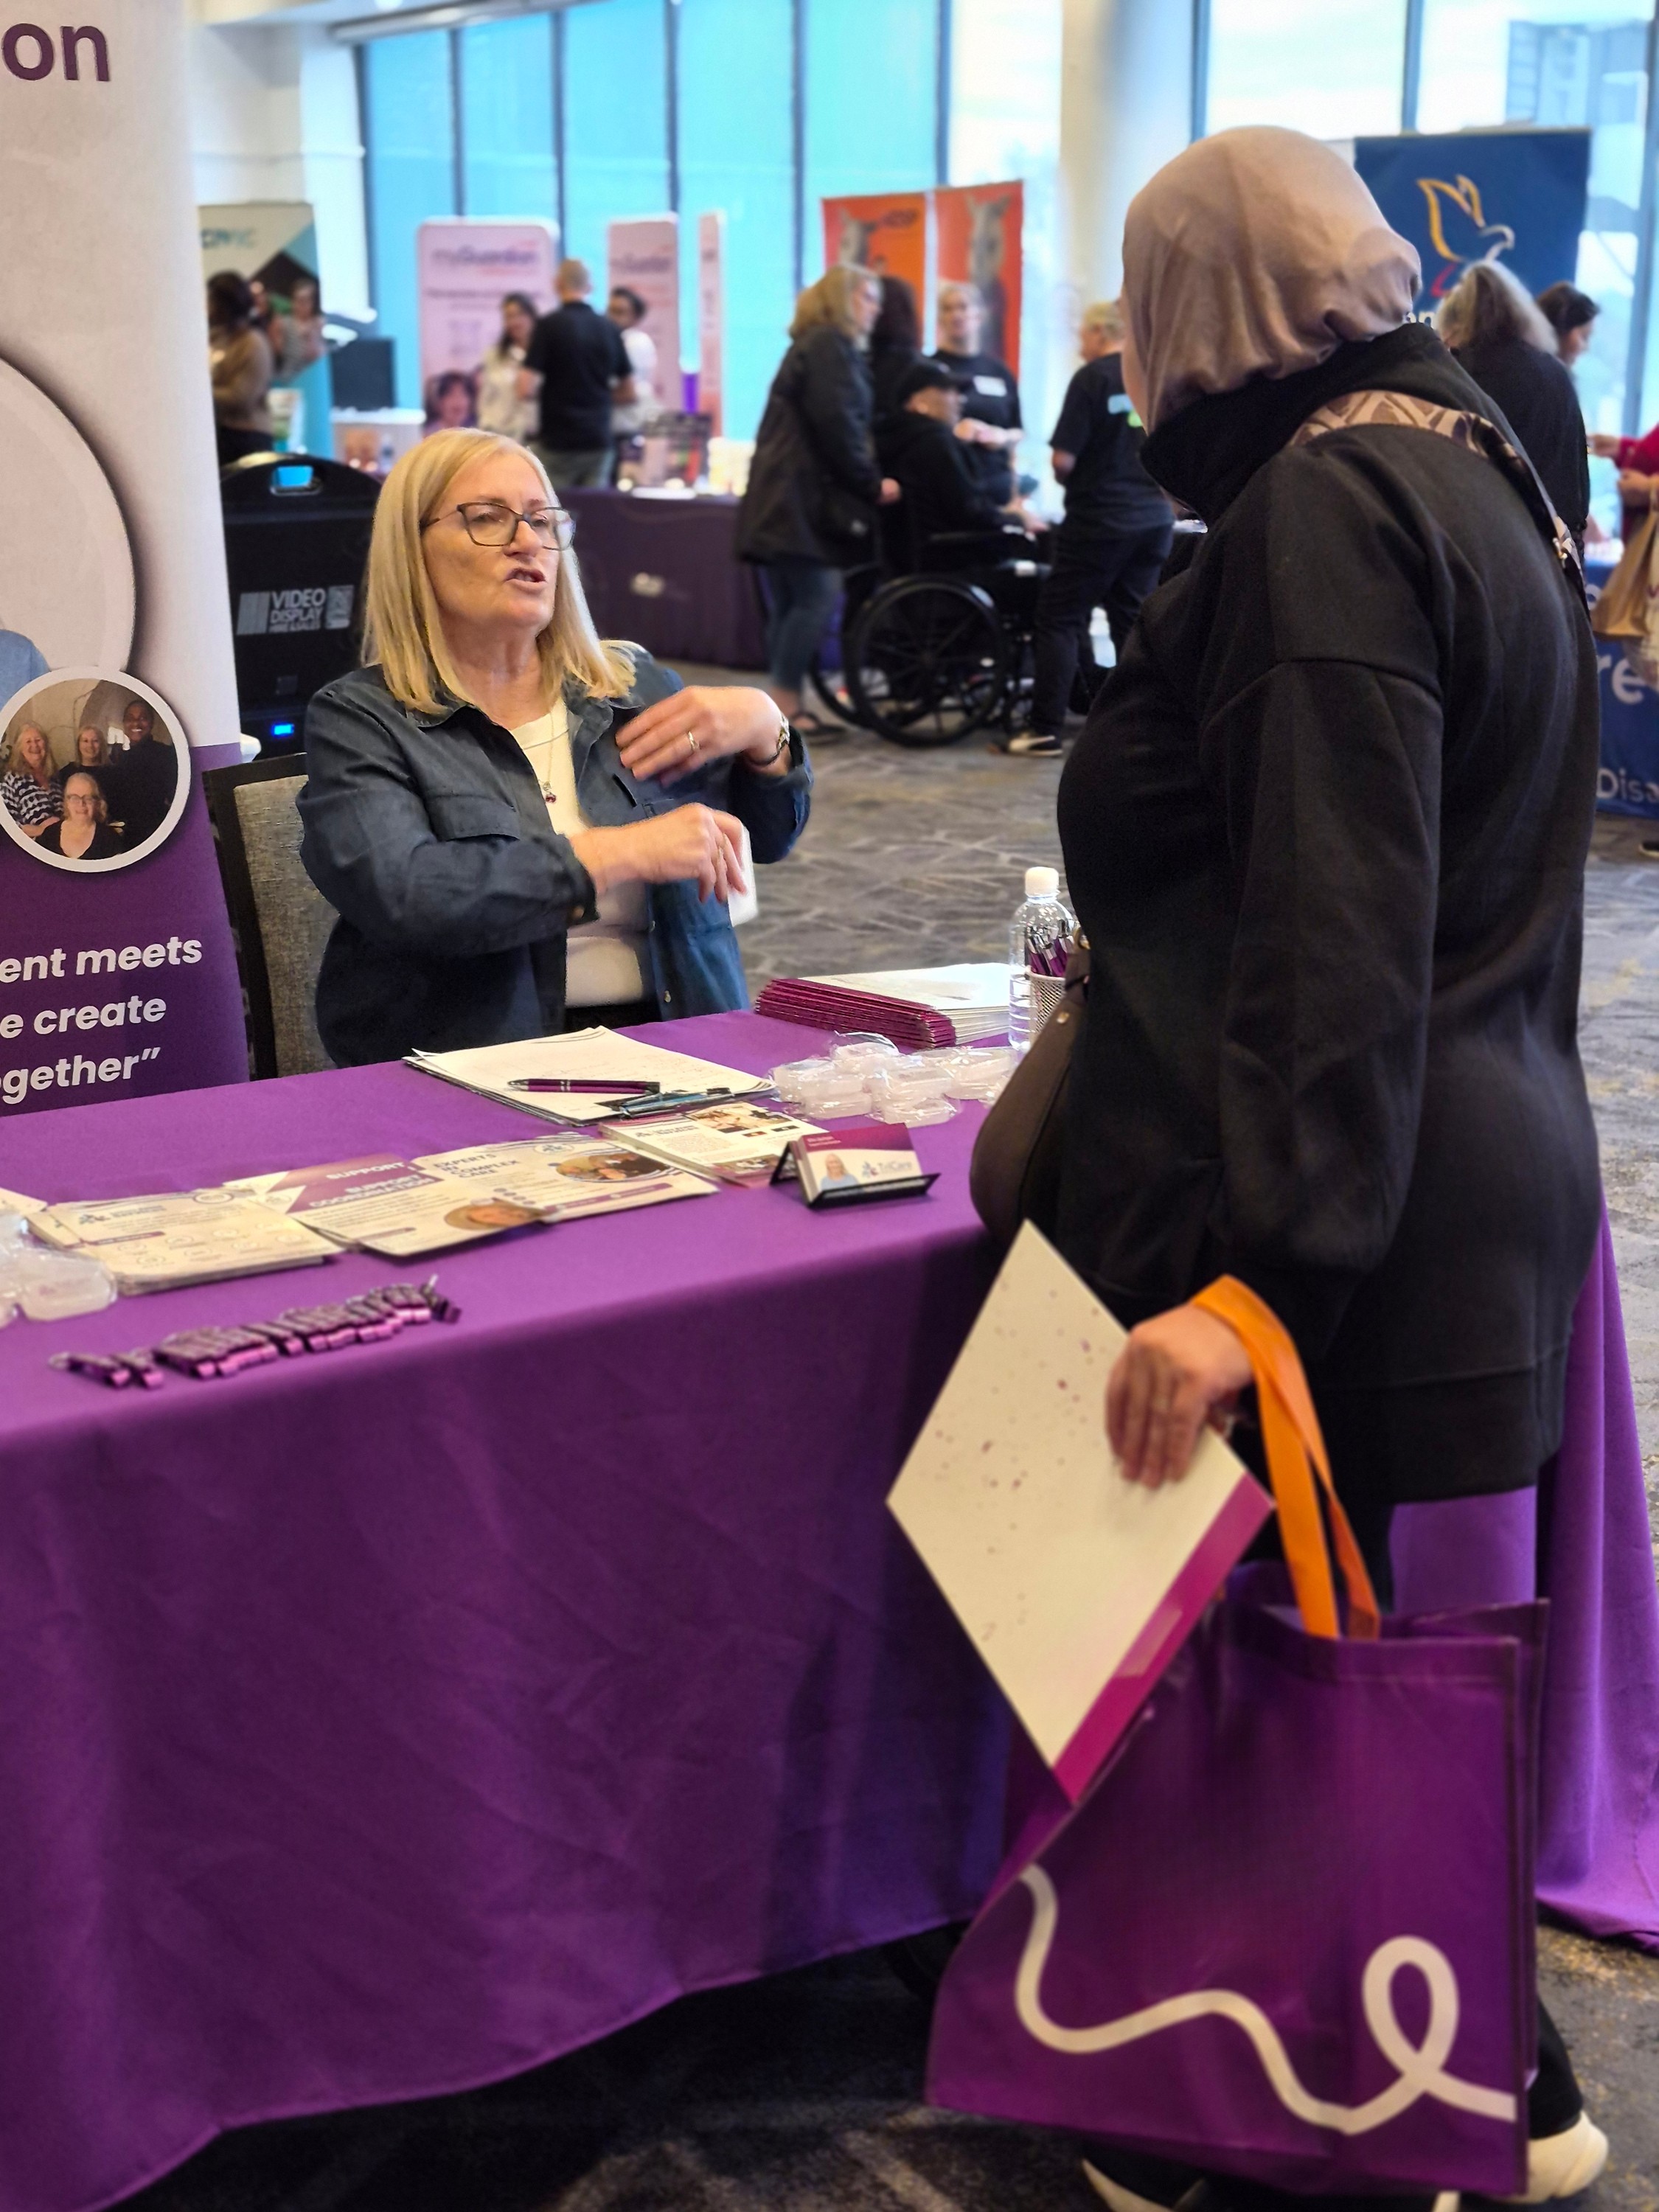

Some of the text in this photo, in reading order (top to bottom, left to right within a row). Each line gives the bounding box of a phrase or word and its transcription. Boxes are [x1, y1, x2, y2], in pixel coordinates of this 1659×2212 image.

[2, 22, 110, 83] on
[271, 588, 326, 609] VIDEO
[270, 606, 323, 624] DISPLAY
[0, 936, 202, 983] ent meets
[0, 995, 167, 1039] e create
[0, 1047, 161, 1105] gether”
[326, 1162, 405, 1179] SUPPORT
[434, 1153, 497, 1168] EXPERTS
[451, 1160, 520, 1175] COMPLEX
